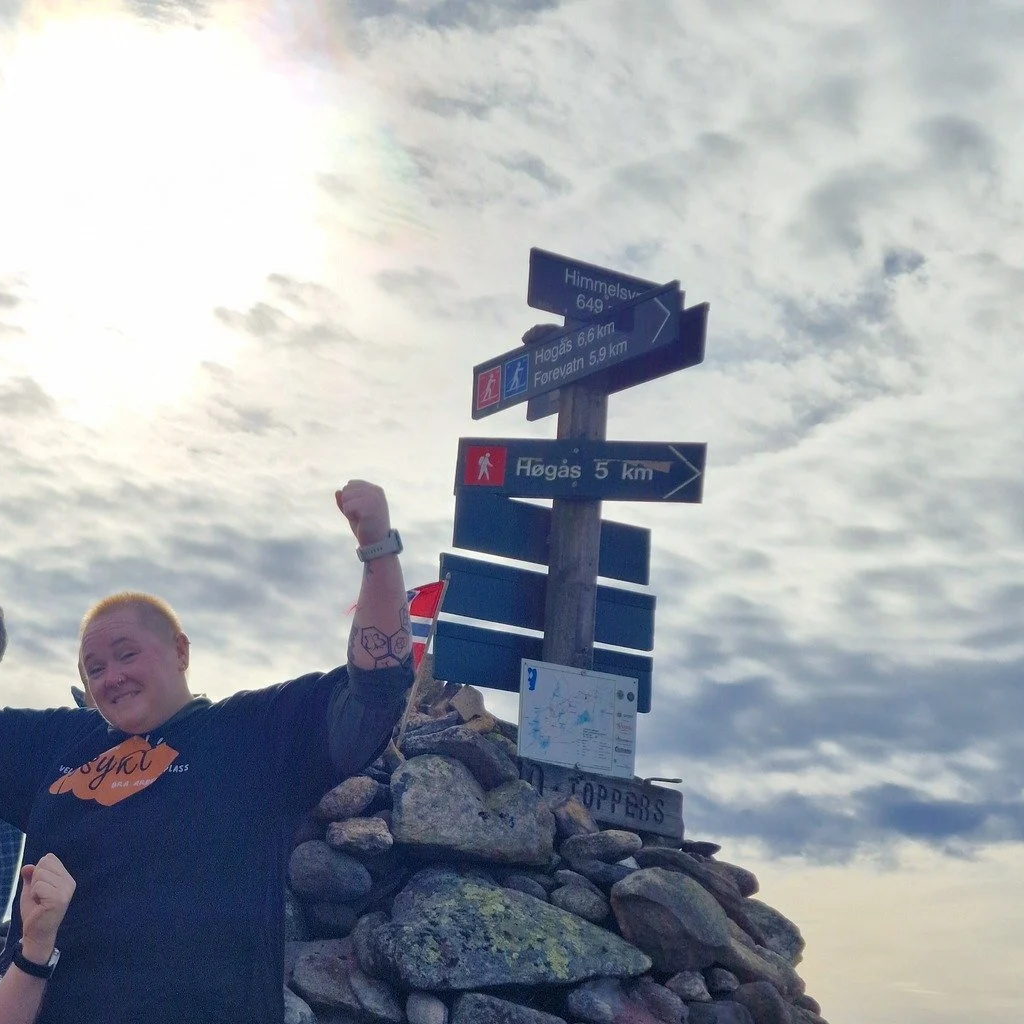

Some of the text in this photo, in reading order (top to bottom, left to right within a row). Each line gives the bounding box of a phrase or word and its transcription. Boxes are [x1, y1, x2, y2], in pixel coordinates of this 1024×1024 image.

[576, 293, 604, 314] 649
[534, 321, 615, 365] Høgås 6,6 km
[589, 346, 607, 366] 5,9
[609, 340, 628, 358] km
[516, 457, 653, 481] Høgås 5 km
